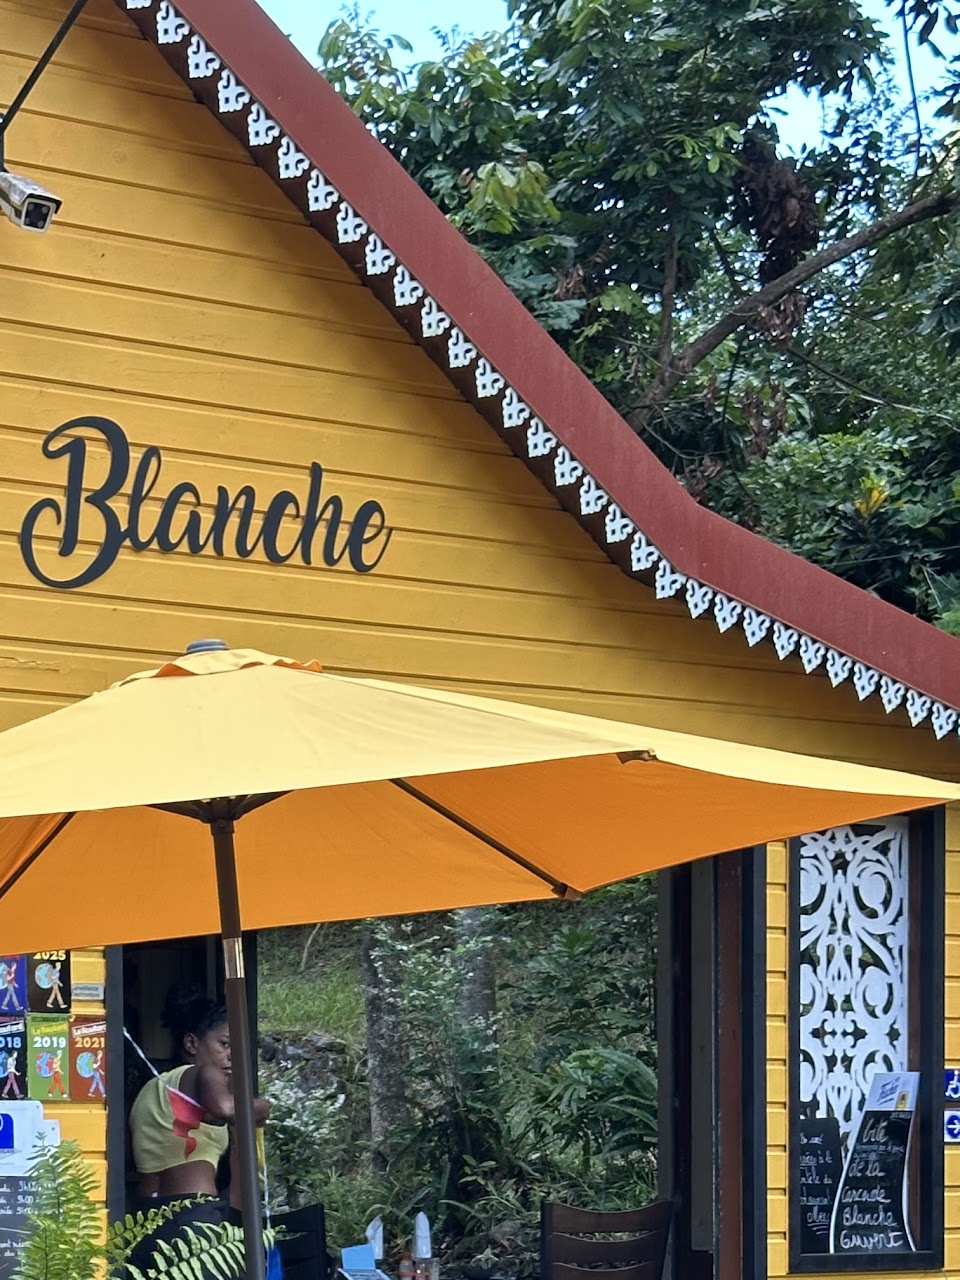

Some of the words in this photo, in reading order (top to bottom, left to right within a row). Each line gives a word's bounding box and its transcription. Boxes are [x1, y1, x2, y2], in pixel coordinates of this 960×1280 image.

[20, 415, 394, 589] Blanche
[33, 1037, 66, 1048] 2019
[74, 1037, 105, 1048] 2021
[841, 1185, 892, 1203] Cascade
[843, 1205, 899, 1227] Blanche
